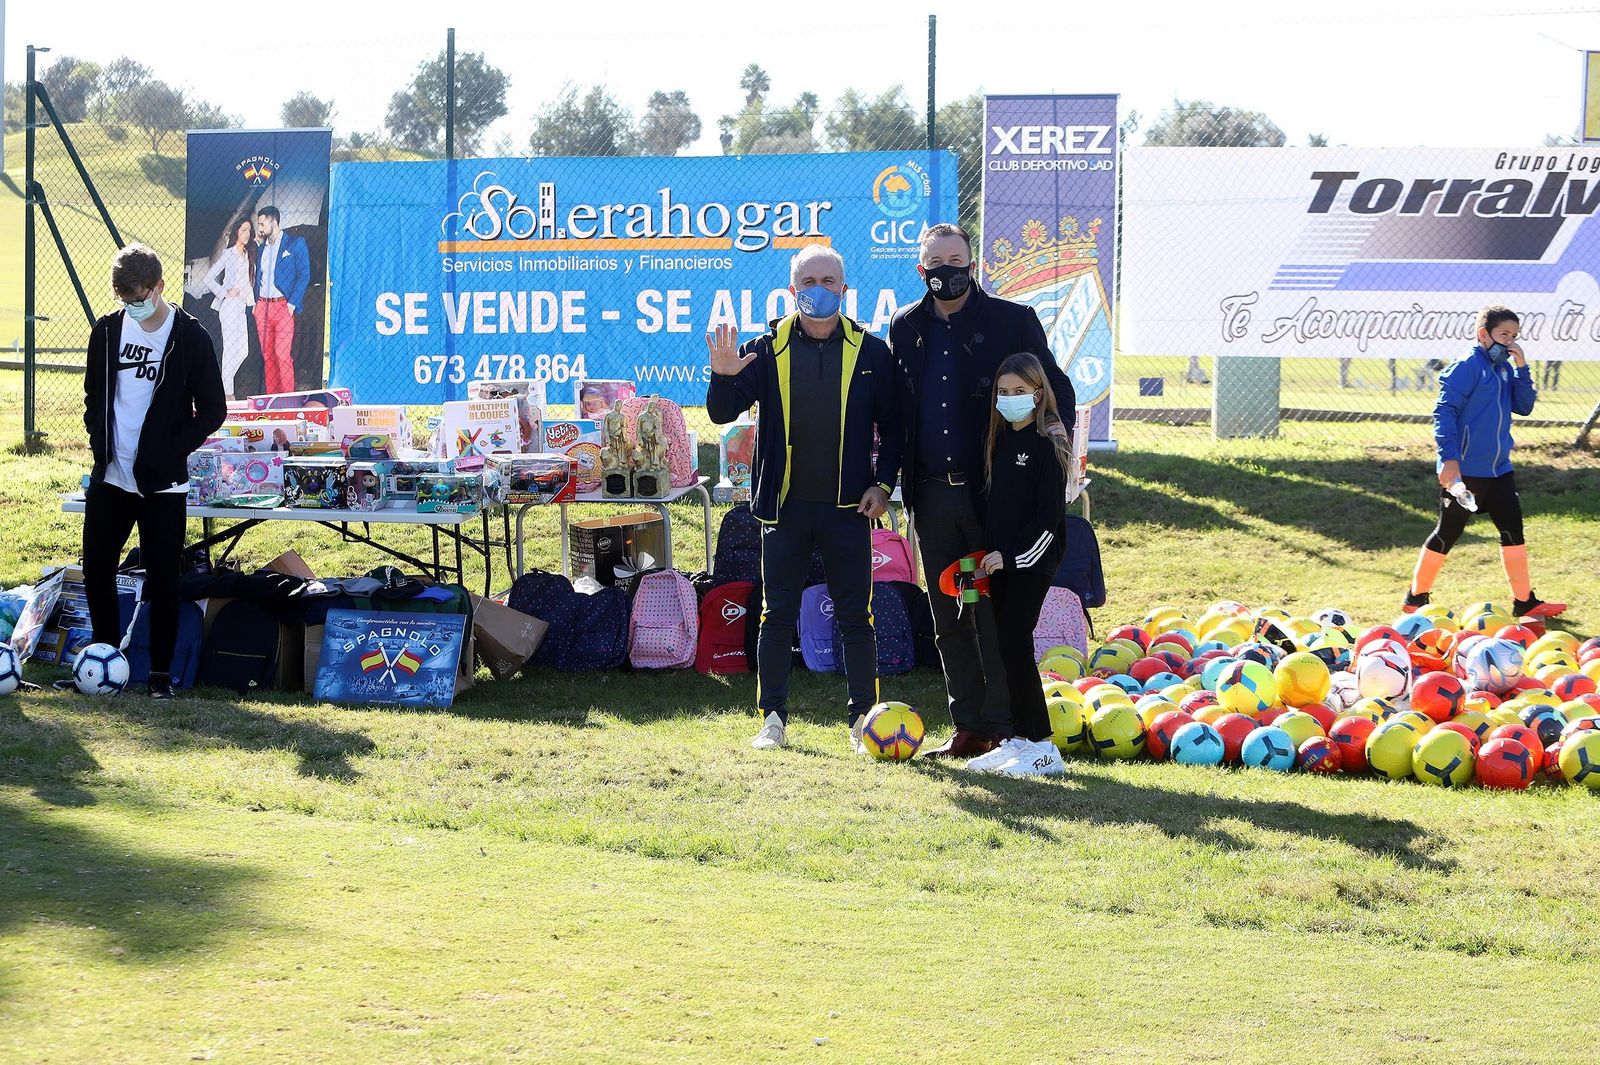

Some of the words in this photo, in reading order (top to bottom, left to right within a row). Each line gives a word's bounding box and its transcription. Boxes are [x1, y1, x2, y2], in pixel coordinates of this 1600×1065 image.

[991, 126, 1112, 155] XEREZ
[235, 156, 280, 171] SPAGNOLO
[906, 160, 923, 174] MLS
[989, 160, 1019, 171] CLUB
[1021, 160, 1088, 171] DEPORTIVO
[1089, 160, 1114, 171] SAD
[1495, 152, 1557, 172] Grupo
[442, 257, 513, 273] Servicios
[519, 255, 617, 272] Inmobiliarios
[624, 260, 633, 274] y
[639, 254, 732, 271] Financieros
[375, 292, 429, 335] SE
[441, 290, 587, 334] VENDE
[636, 288, 692, 333] SE
[1220, 291, 1259, 342] Te
[120, 343, 153, 361] JUST
[135, 364, 157, 381] DO
[414, 354, 465, 384] 673
[474, 354, 526, 383] 478
[535, 353, 587, 383] 864
[468, 403, 509, 411] MULTIPIN
[469, 410, 510, 420] BLOQUES
[546, 424, 569, 440] Yeti
[343, 627, 441, 656] SPAGNOLO
[1032, 754, 1054, 771] Fila
